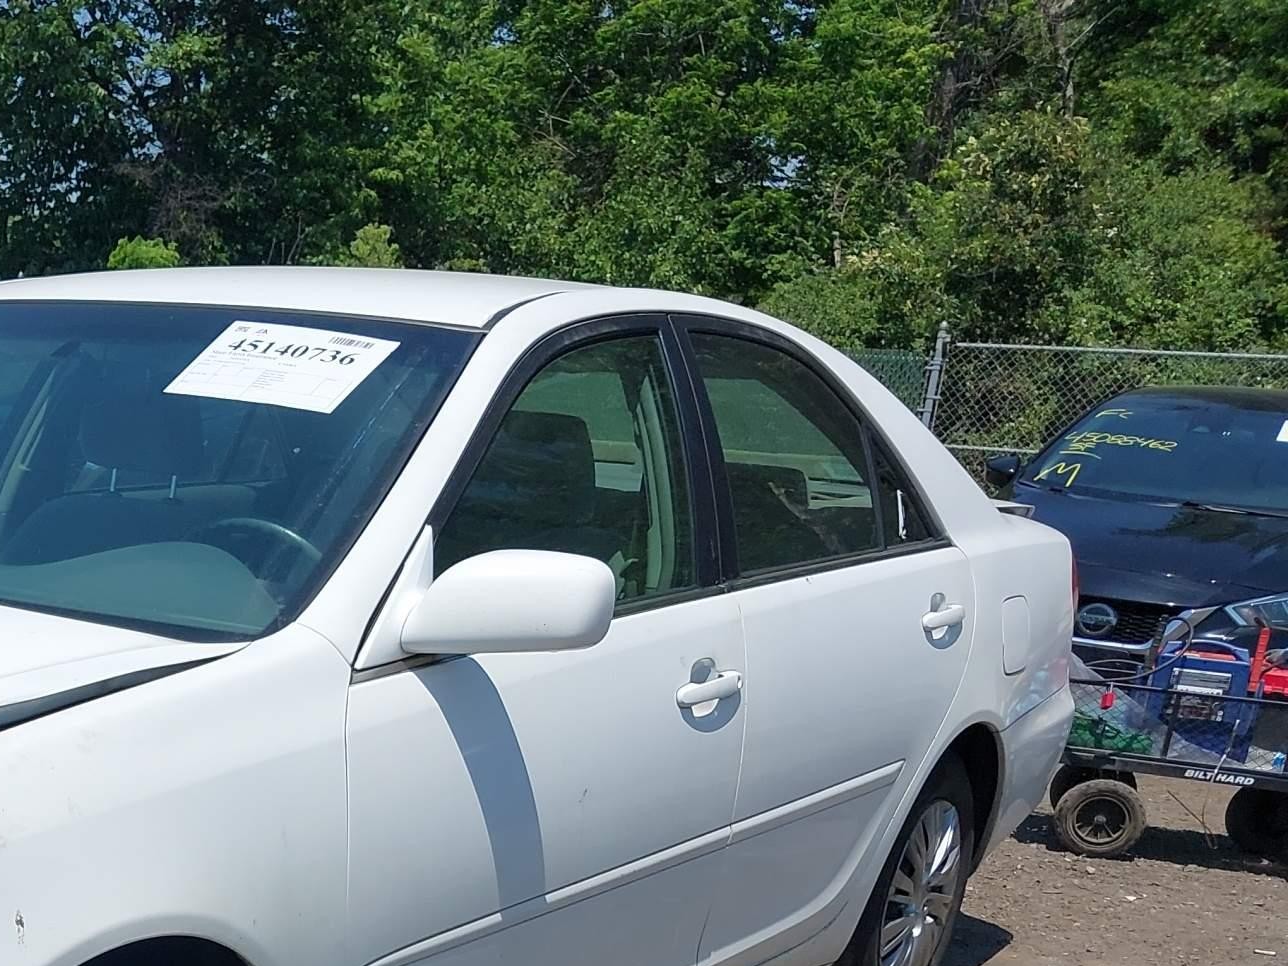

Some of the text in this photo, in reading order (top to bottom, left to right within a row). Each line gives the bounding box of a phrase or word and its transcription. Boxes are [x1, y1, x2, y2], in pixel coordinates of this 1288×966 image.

[227, 338, 361, 366] 45140736
[1064, 431, 1179, 452] 45088462
[1183, 769, 1255, 786] BILT HARD
